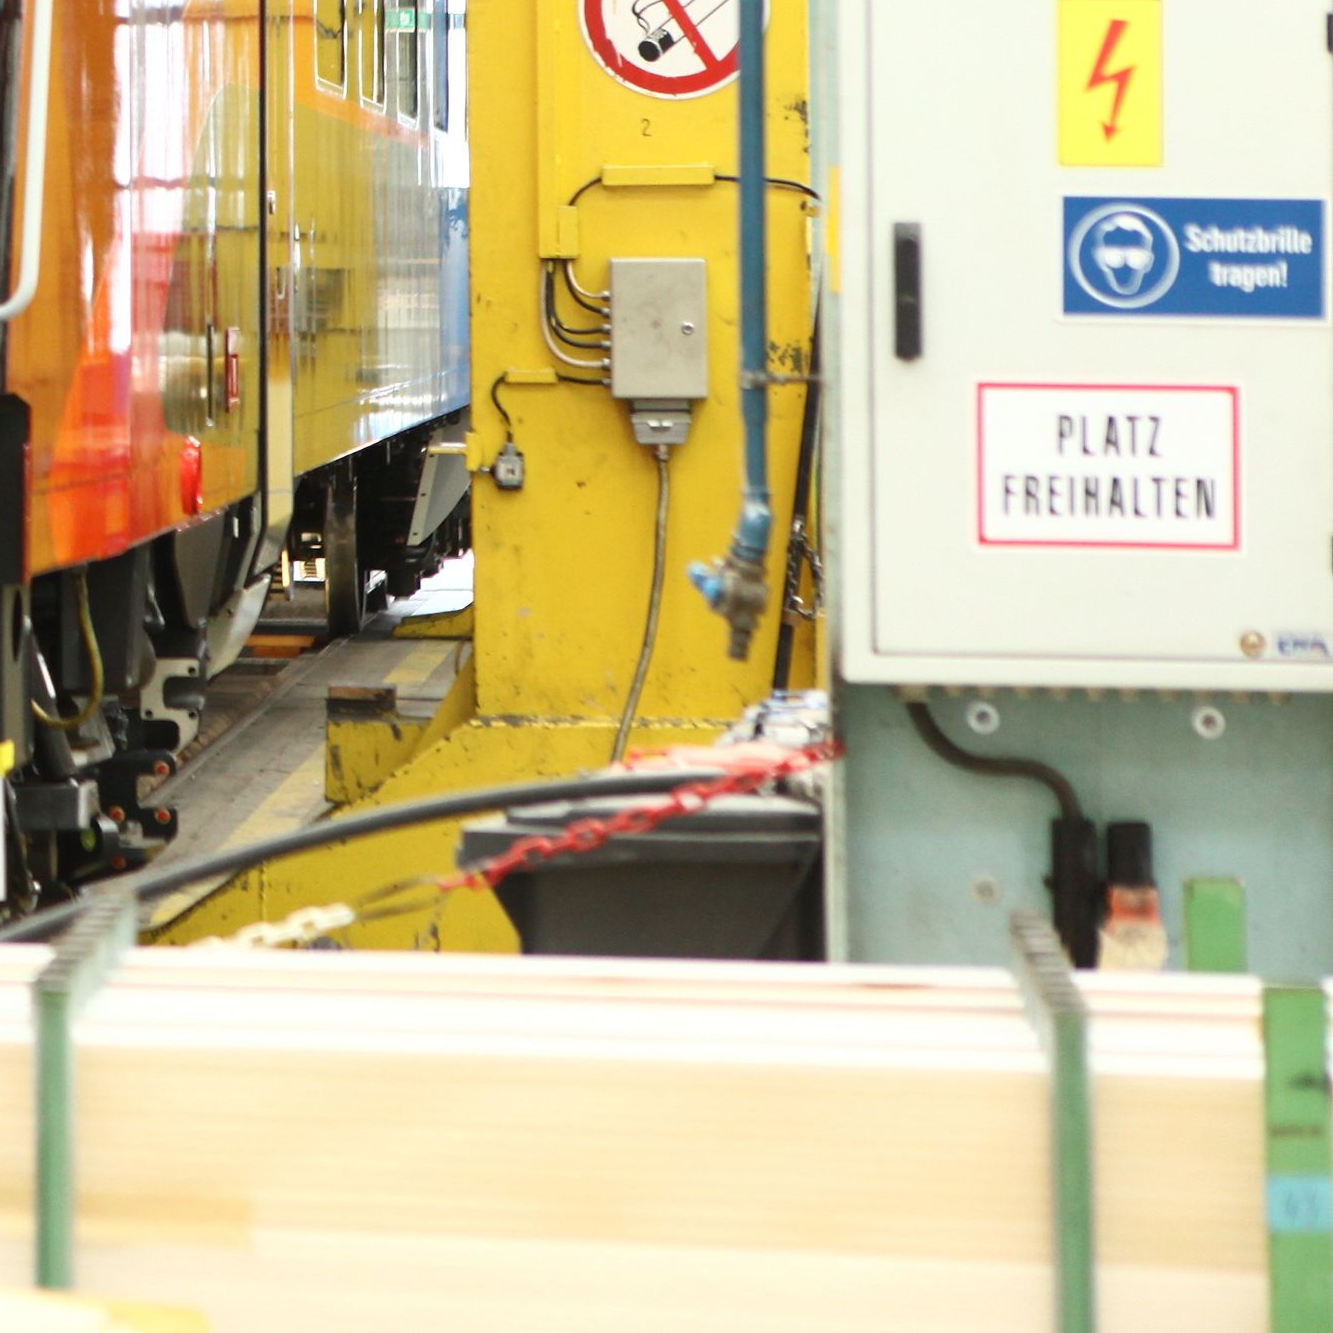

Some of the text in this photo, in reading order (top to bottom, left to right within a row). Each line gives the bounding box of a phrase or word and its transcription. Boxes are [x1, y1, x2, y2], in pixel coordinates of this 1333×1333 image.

[640, 118, 653, 137] 2
[1184, 223, 1312, 254] Schutzbrille
[1209, 261, 1288, 292] tragen!
[1056, 414, 1162, 456] PLATZ
[1002, 474, 1215, 518] FREIHALTEN
